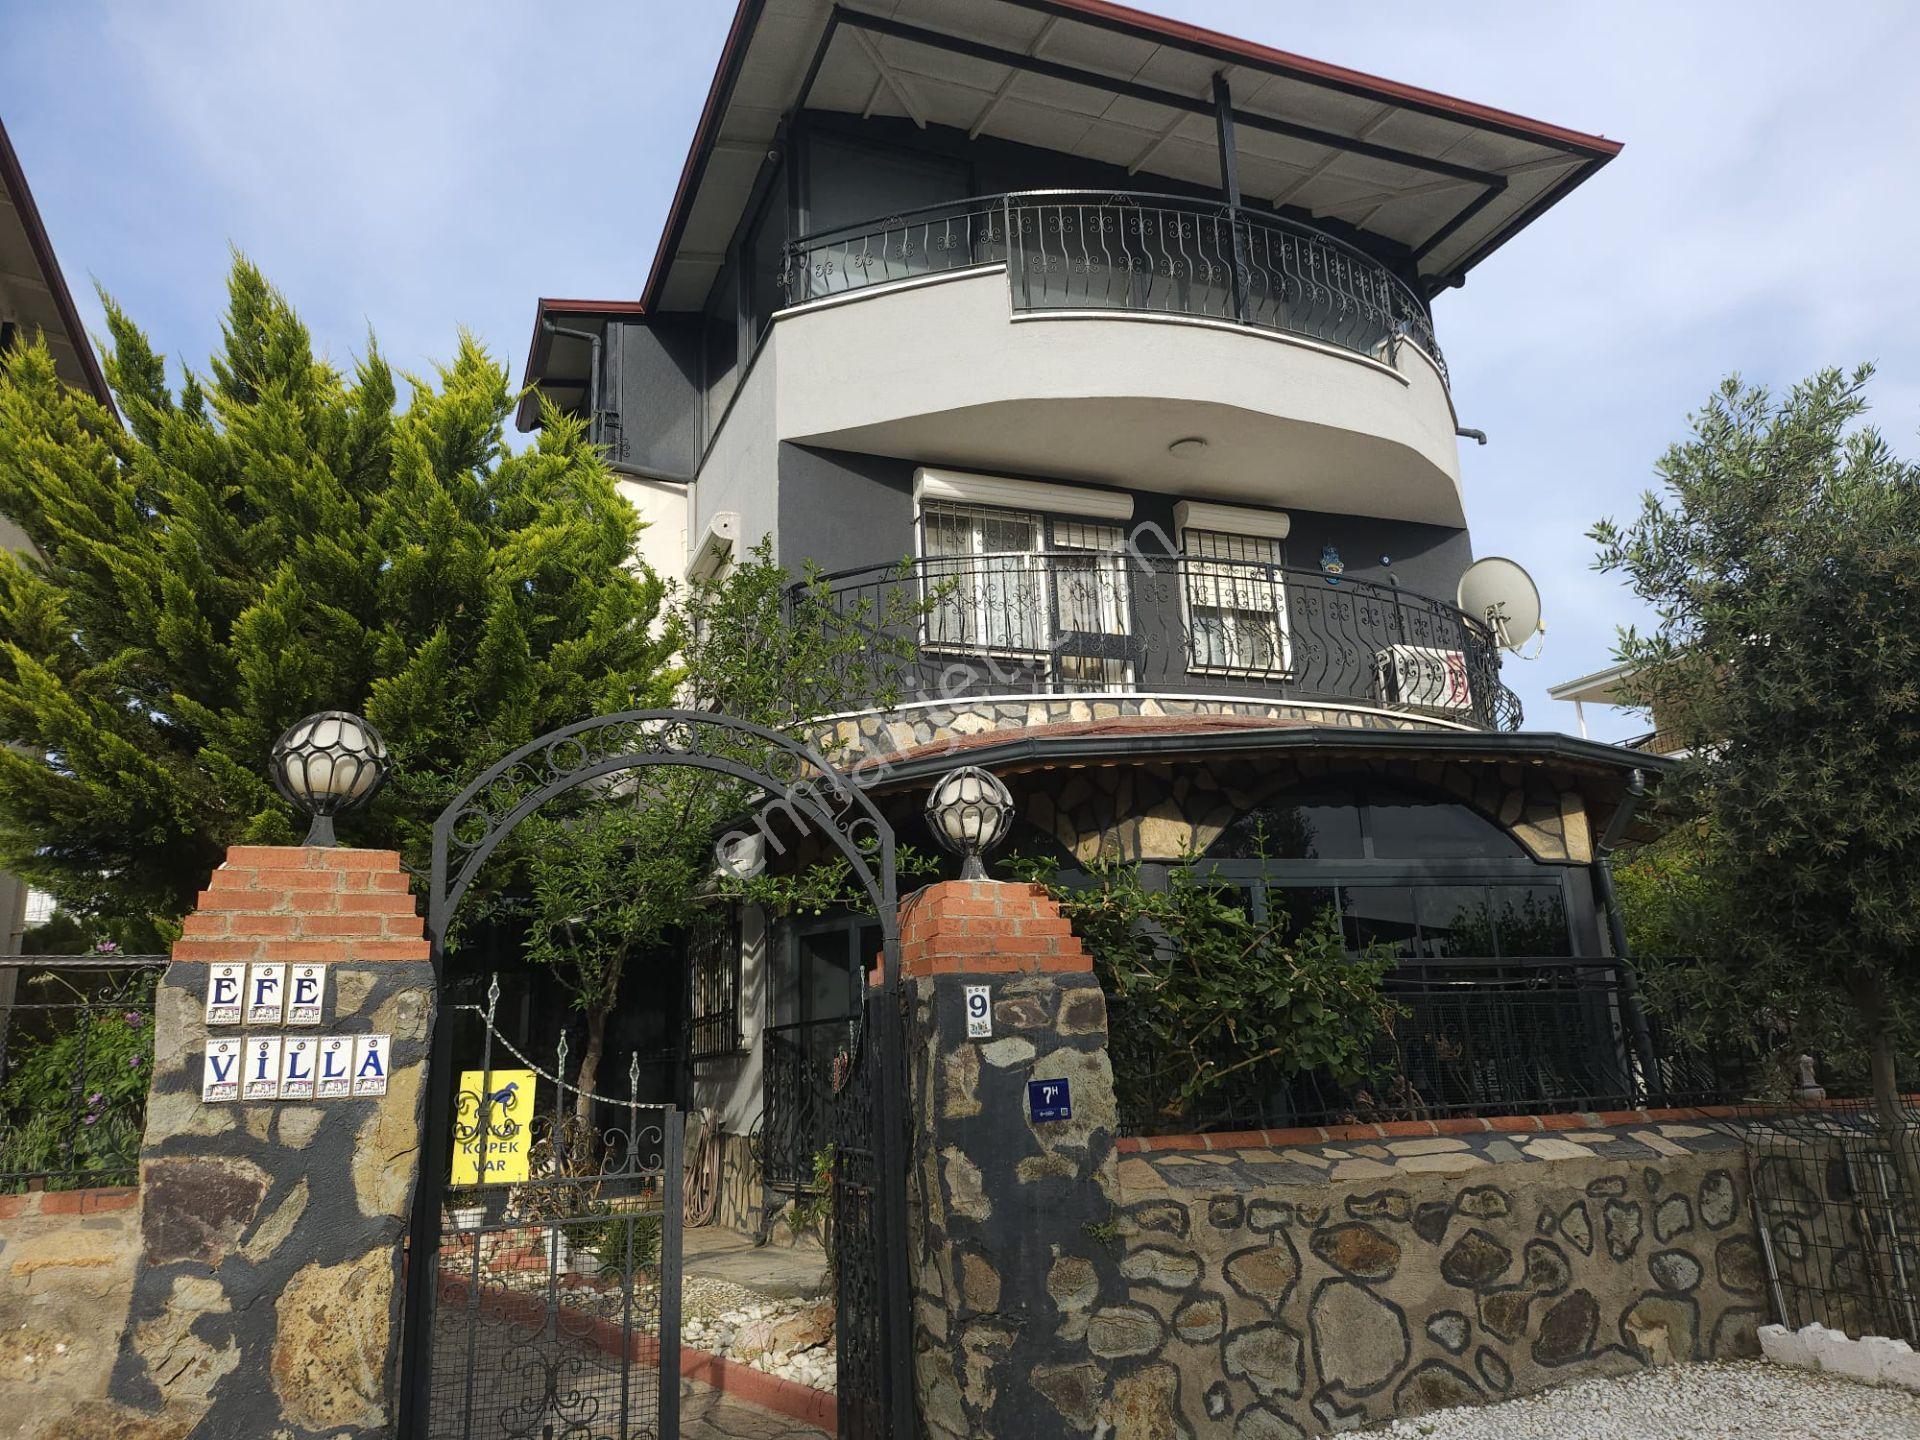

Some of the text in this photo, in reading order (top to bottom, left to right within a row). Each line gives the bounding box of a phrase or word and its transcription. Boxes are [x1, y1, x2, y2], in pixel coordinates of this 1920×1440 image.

[212, 977, 319, 1005] EFE
[969, 994, 987, 1018] 9
[462, 1123, 523, 1137] DKAT
